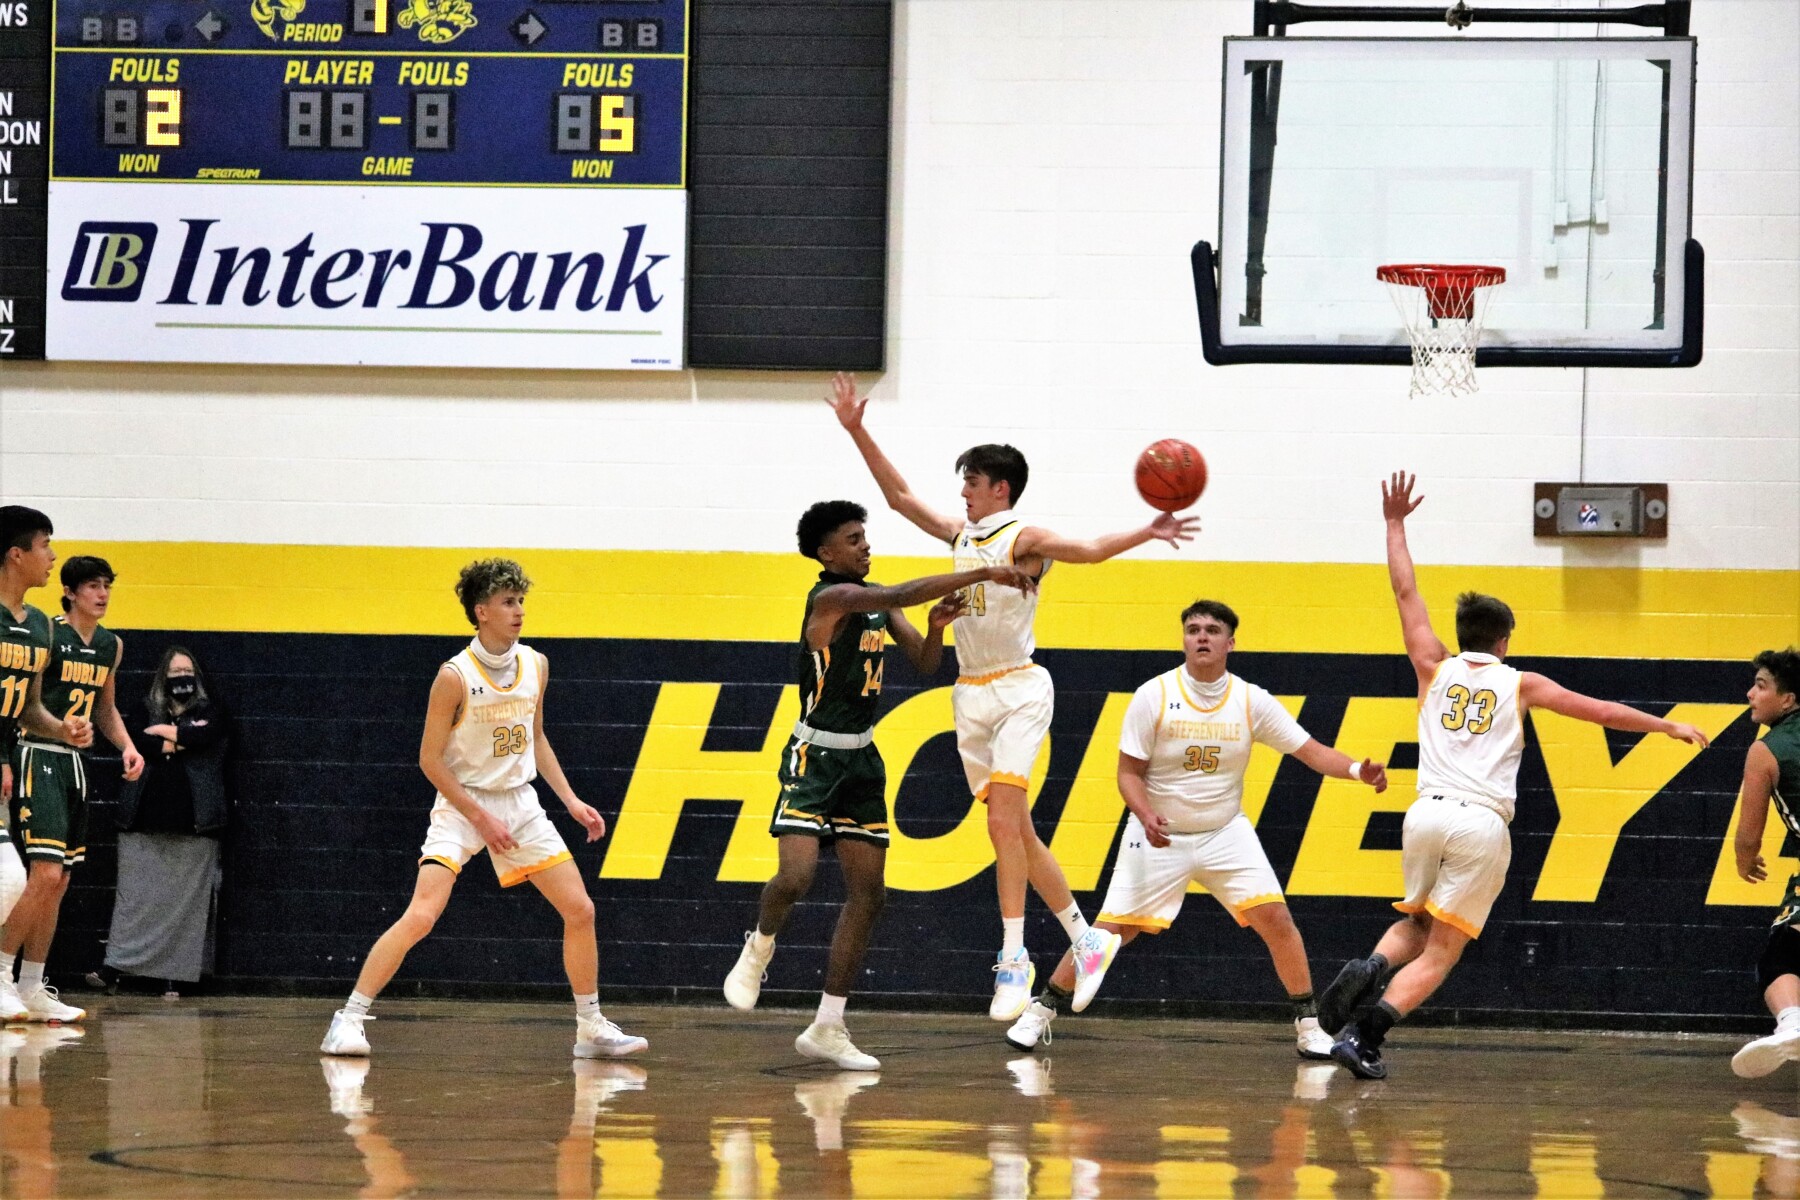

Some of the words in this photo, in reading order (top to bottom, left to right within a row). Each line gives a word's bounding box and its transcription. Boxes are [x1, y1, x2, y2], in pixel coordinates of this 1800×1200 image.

[283, 23, 343, 43] PERIOD
[109, 58, 180, 83] FOULS
[284, 60, 375, 85] PLAYER
[397, 61, 469, 86] FOULS
[562, 64, 634, 88] FOULS
[118, 154, 160, 173] WON
[196, 168, 260, 179] SPECTRUM
[361, 156, 414, 177] GAME
[571, 160, 614, 178] WON
[0, 180, 18, 204] L
[156, 218, 671, 314] InterBank
[861, 657, 884, 697] 14
[0, 675, 29, 719] 11
[64, 688, 96, 722] 21
[1441, 684, 1498, 735] 33
[493, 724, 528, 758] 23
[1168, 720, 1241, 742] STEPHENVILLE
[1183, 745, 1221, 774] 35
